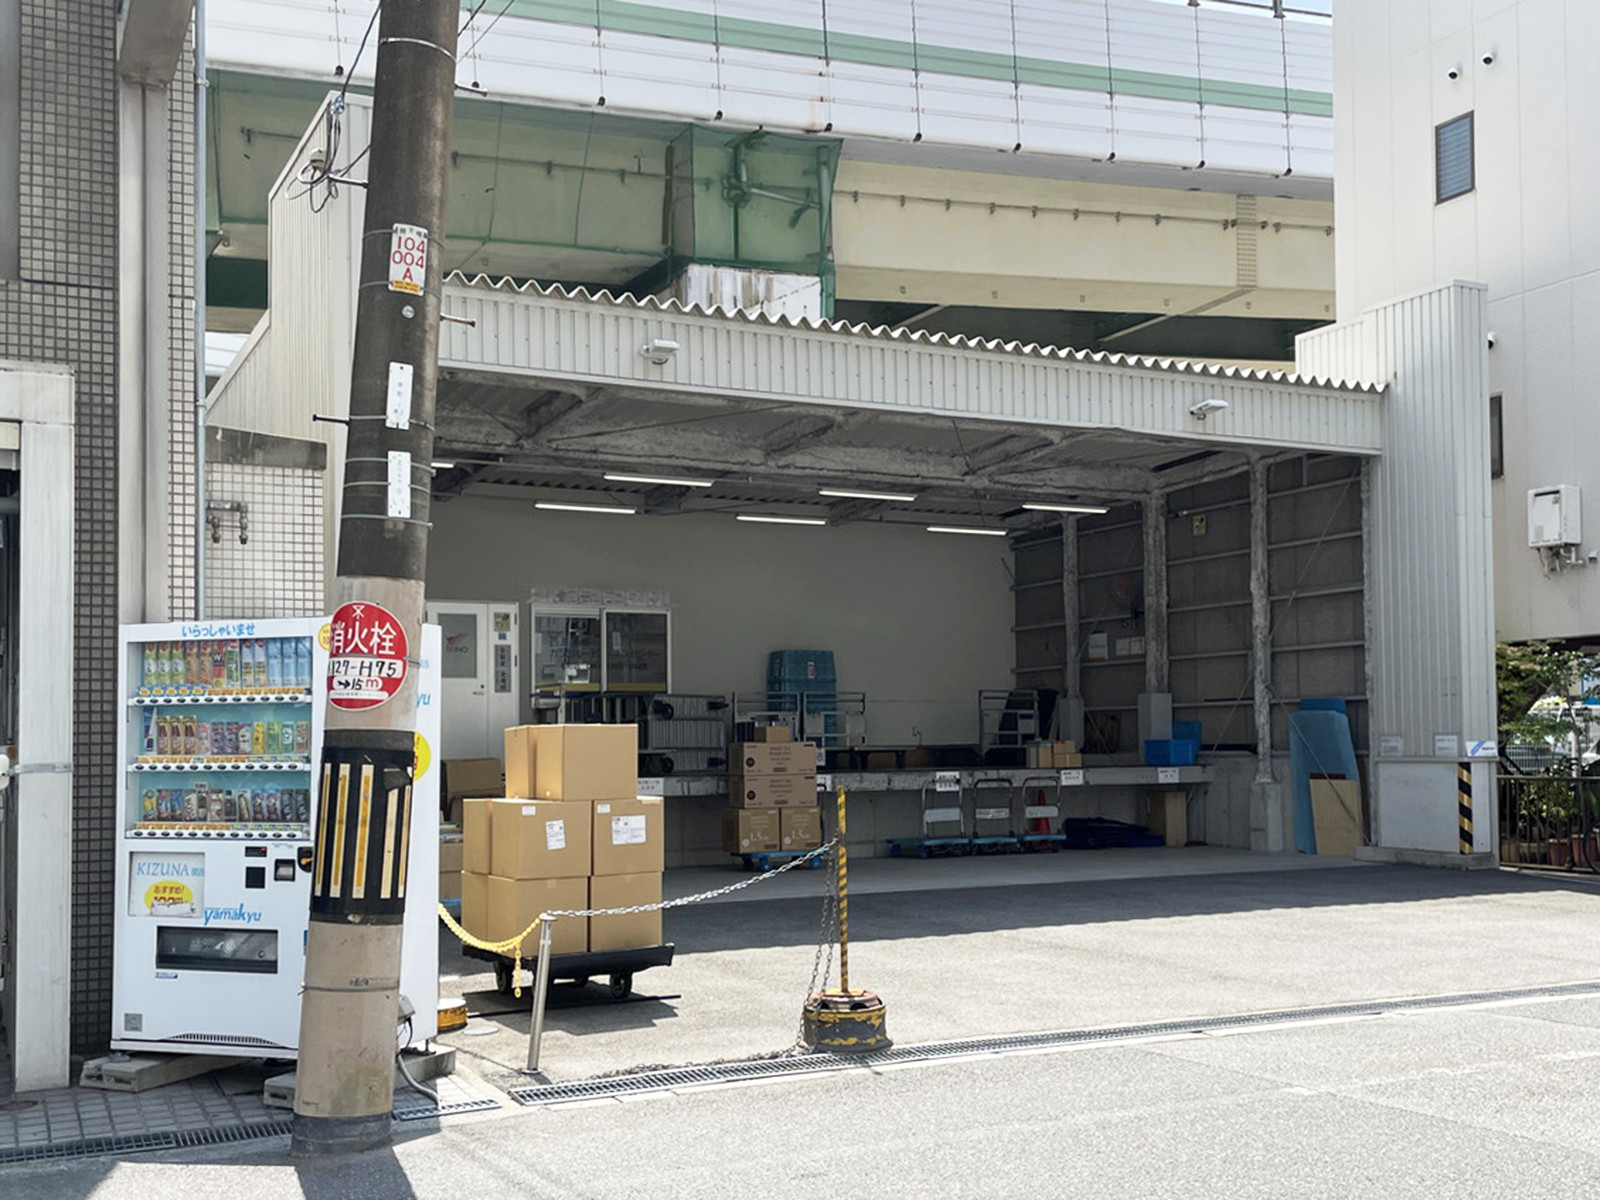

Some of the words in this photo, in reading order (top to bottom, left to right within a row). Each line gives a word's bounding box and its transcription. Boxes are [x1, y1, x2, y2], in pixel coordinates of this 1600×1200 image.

[397, 235, 426, 254] 104
[391, 250, 425, 269] 004
[402, 267, 414, 282] A
[181, 623, 256, 637] いらっしゃいませ
[136, 862, 190, 877] KIZUNA
[203, 902, 262, 926] yamakyu
